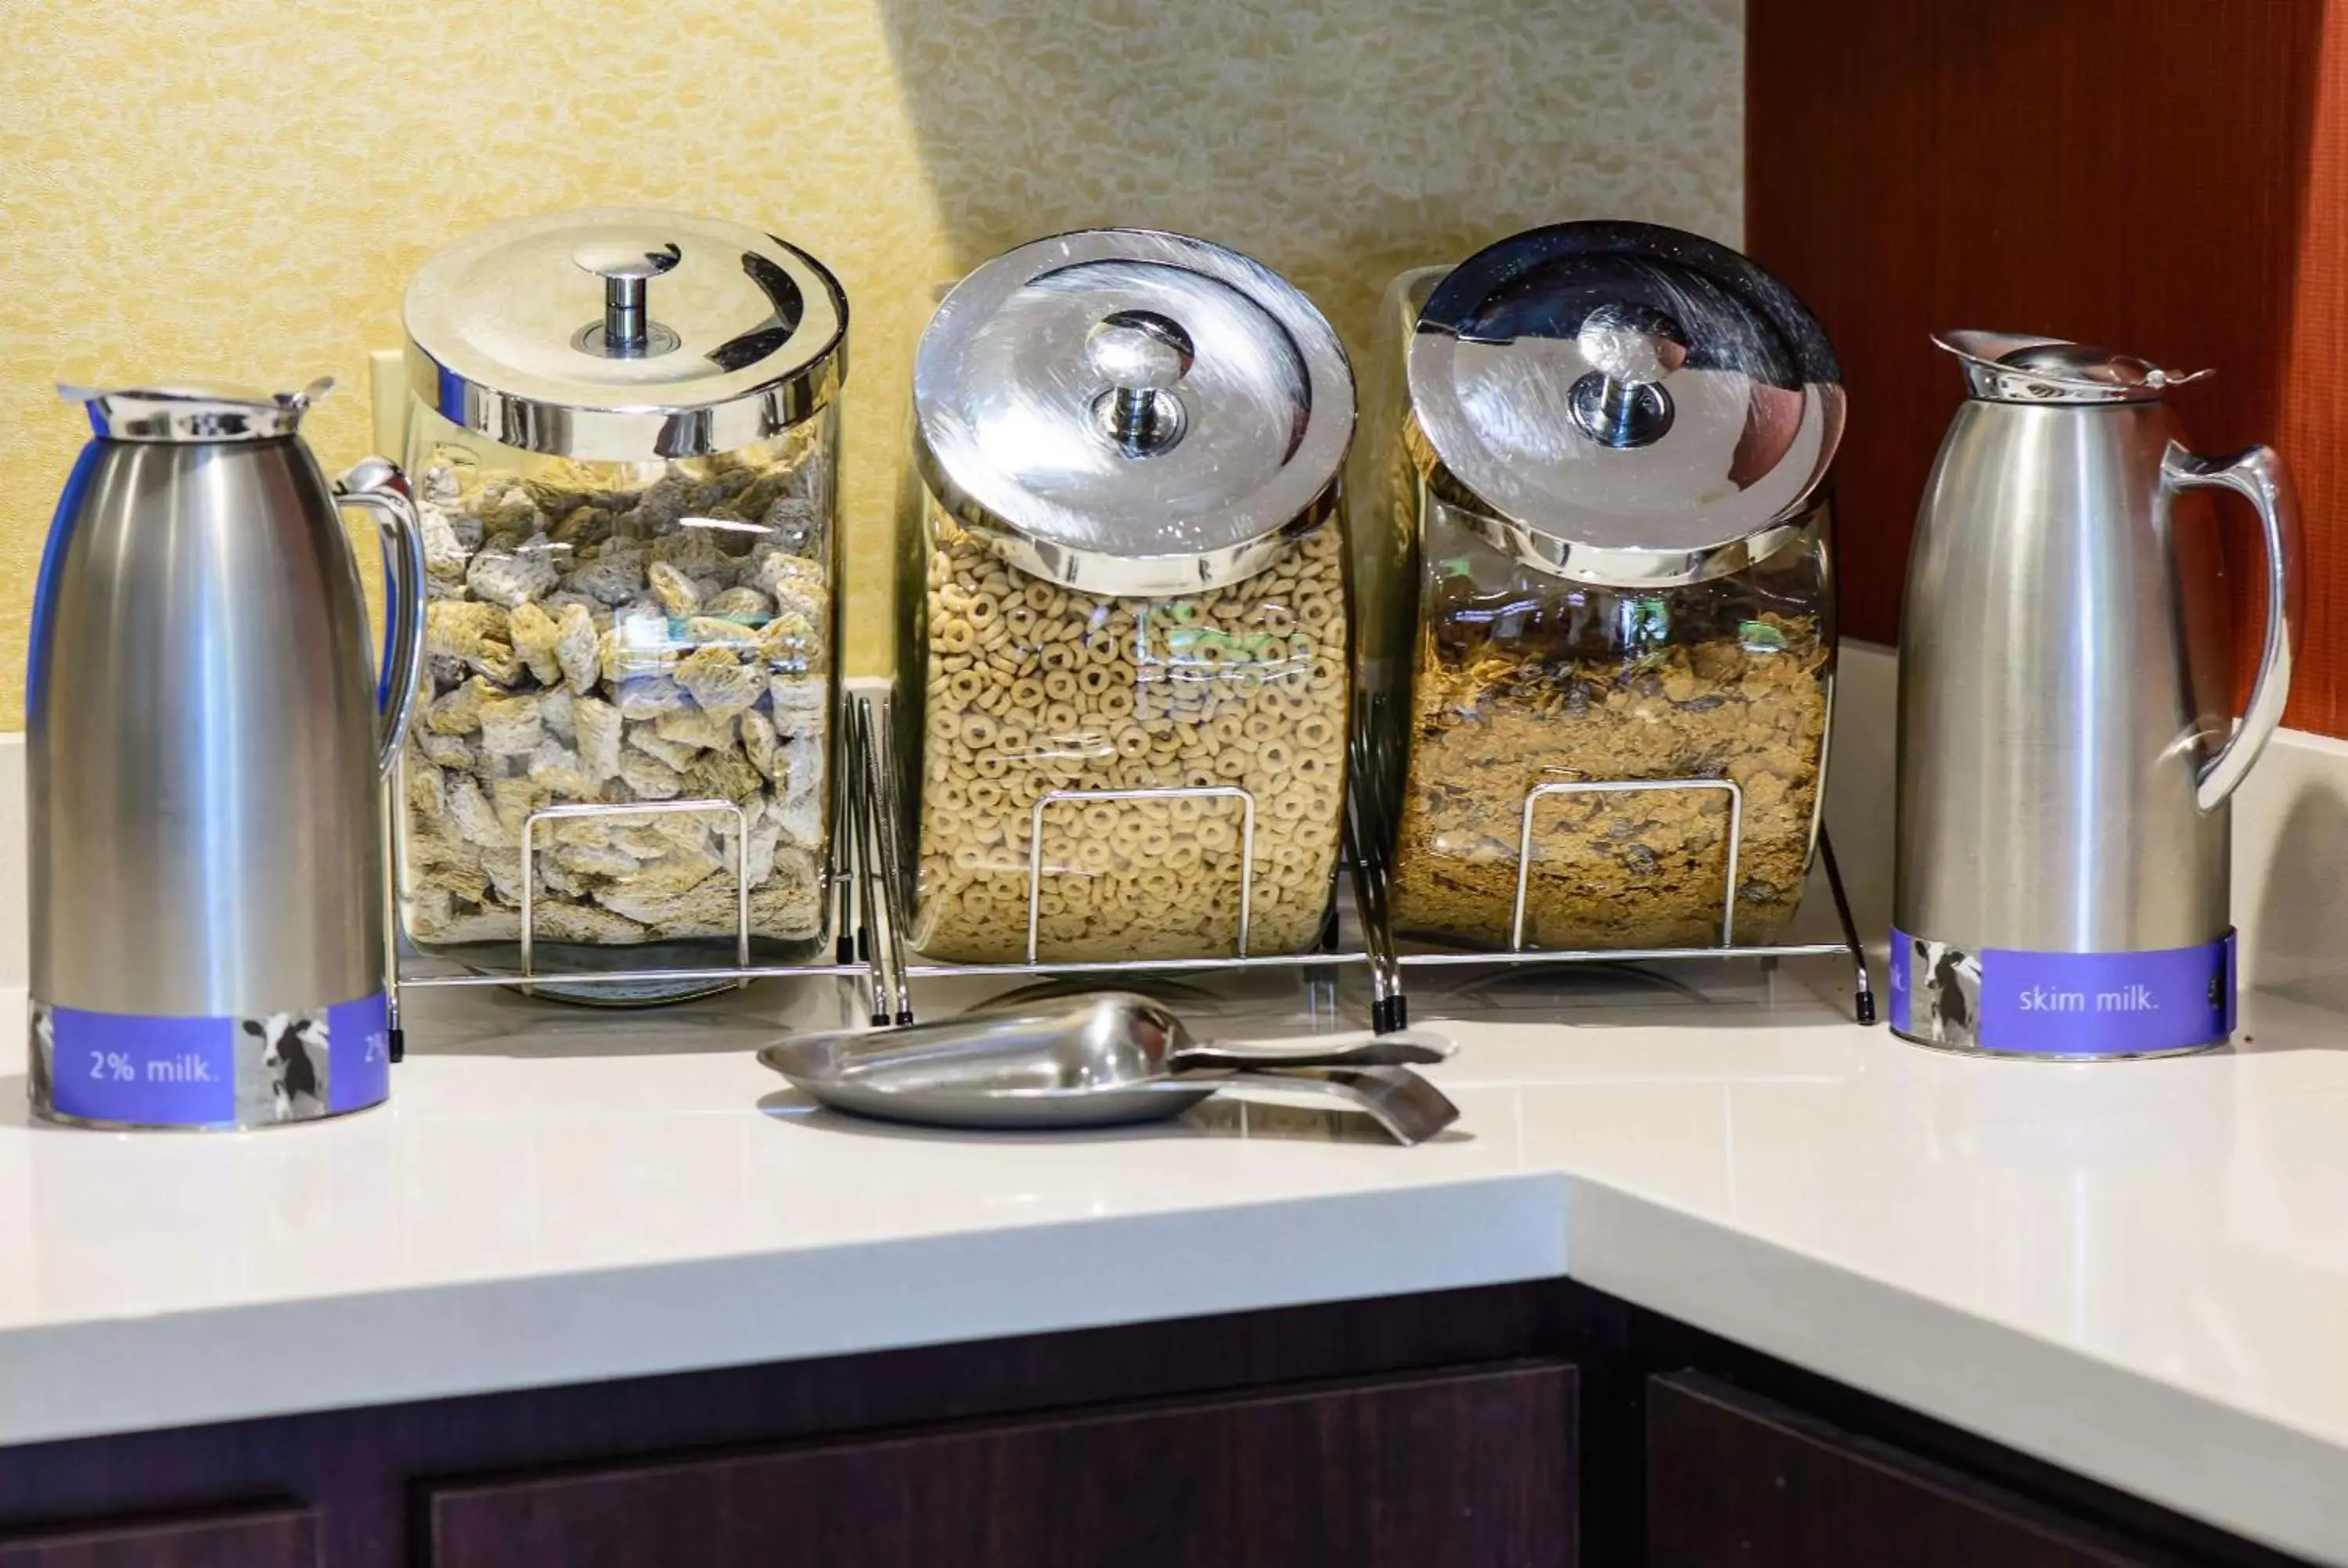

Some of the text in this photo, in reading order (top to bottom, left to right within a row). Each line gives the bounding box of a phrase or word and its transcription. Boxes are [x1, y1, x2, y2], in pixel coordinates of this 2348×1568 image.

[2019, 984, 2159, 1011] skim milk.
[89, 1051, 220, 1081] 2% milk.
